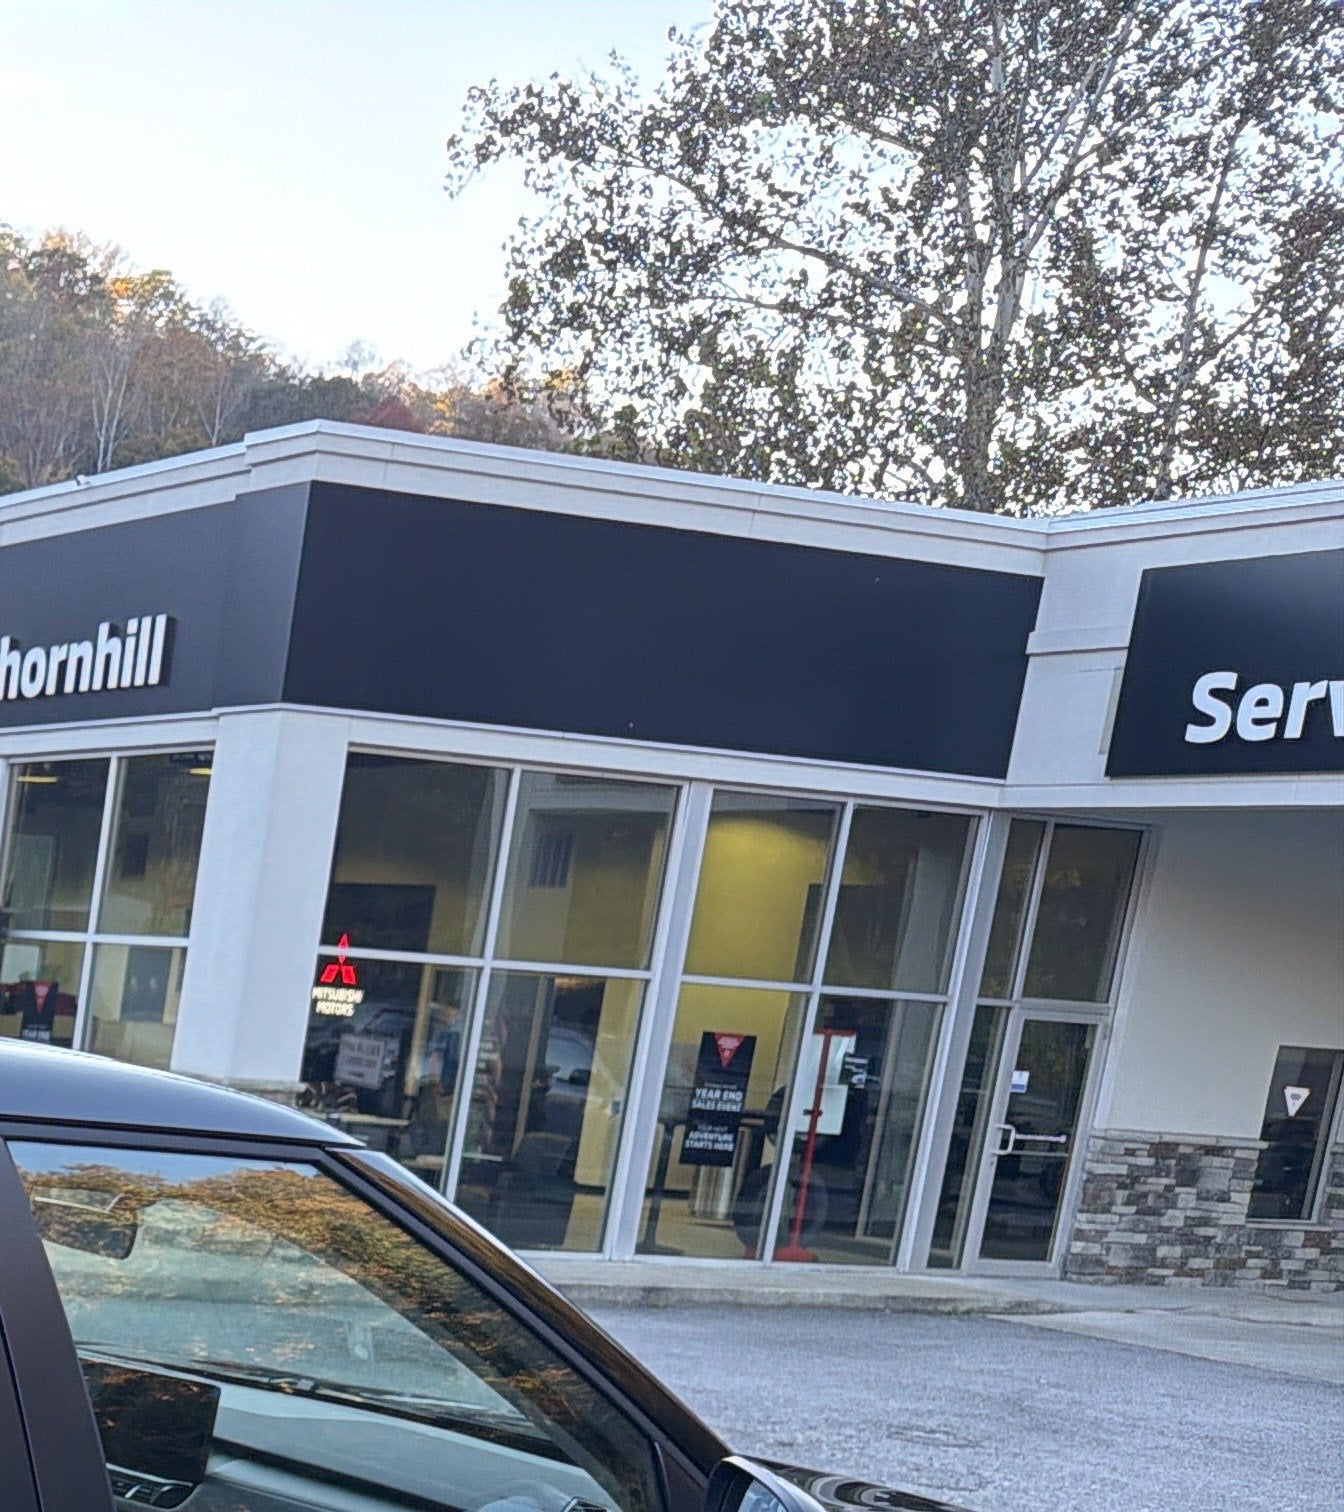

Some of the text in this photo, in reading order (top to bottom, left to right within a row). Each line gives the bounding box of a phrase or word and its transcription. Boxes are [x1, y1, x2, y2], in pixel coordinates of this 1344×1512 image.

[312, 986, 364, 1004] MITSUBISHI
[316, 1001, 354, 1017] MOTORS
[695, 1088, 743, 1102] YEAR END
[692, 1099, 715, 1111] SALES
